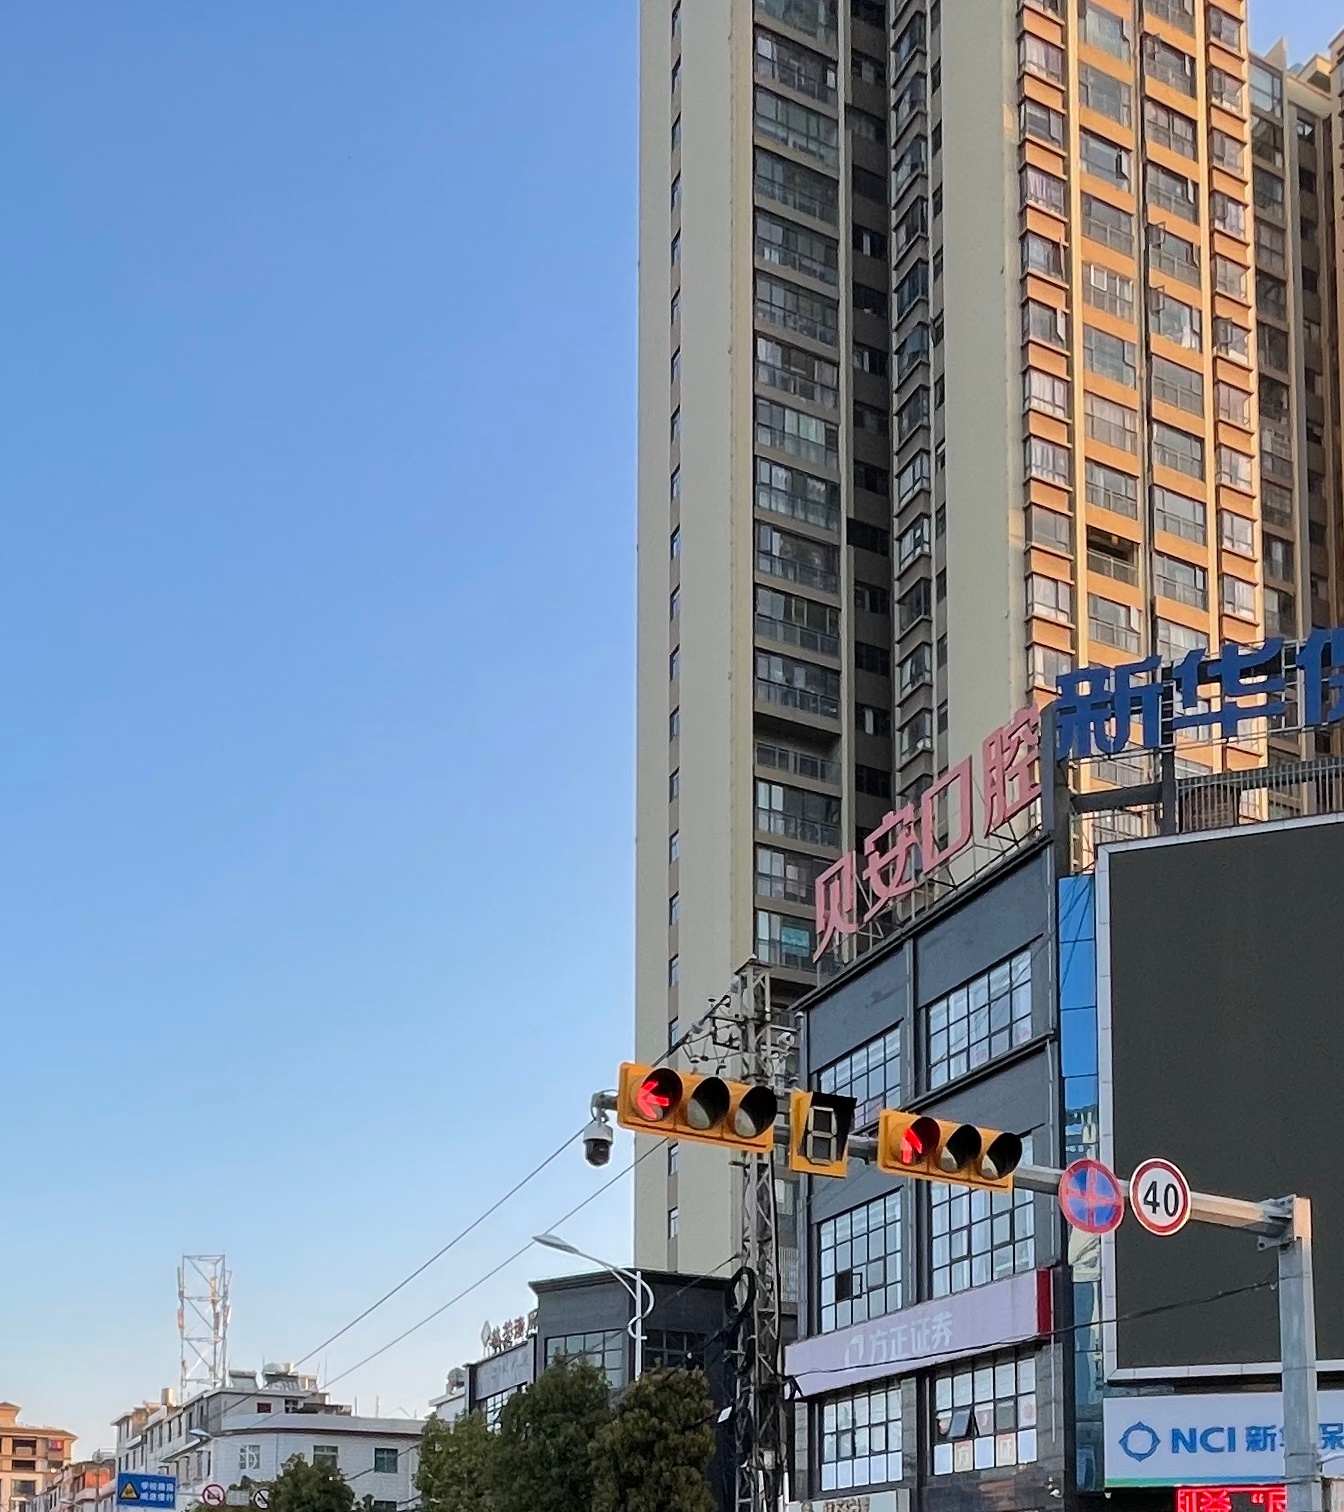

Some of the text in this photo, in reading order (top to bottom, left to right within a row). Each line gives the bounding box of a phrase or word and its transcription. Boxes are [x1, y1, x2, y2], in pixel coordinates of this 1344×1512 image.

[812, 706, 1042, 963] 贝安口腔
[1143, 1180, 1179, 1219] 40
[868, 1310, 954, 1363] 方正证券
[1171, 1426, 1236, 1455] NCI
